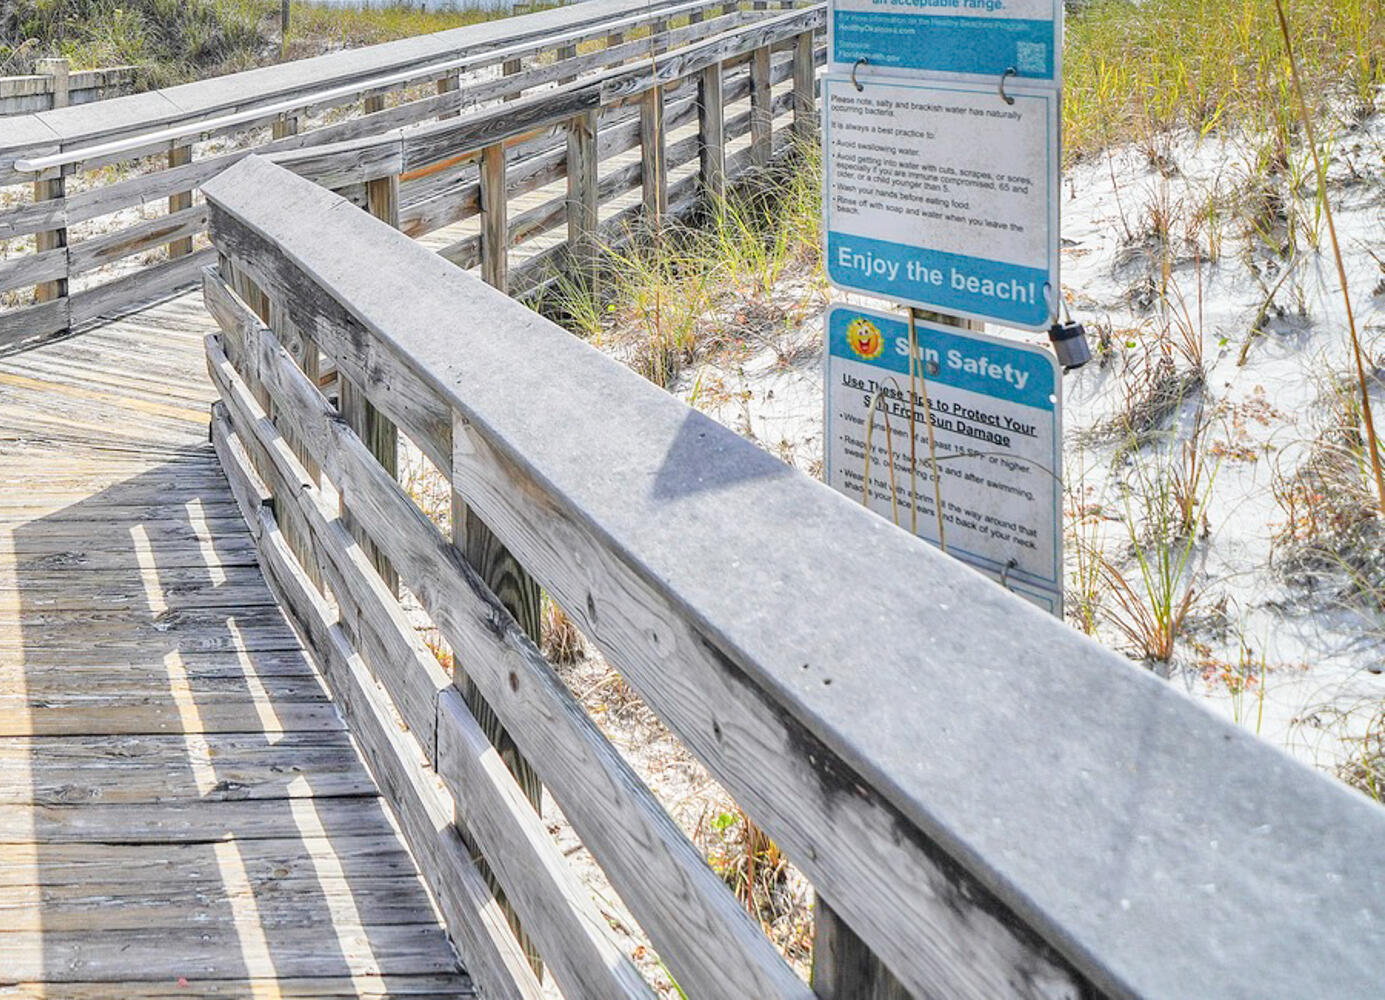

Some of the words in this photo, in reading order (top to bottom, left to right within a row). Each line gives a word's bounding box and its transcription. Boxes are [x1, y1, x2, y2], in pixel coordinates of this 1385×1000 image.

[831, 95, 855, 104] Please
[876, 100, 894, 109] salty
[911, 102, 943, 112] brackish
[945, 106, 967, 115] water
[969, 108, 984, 116] has
[986, 110, 1023, 121] naturally
[838, 122, 844, 130] is
[845, 123, 869, 133] always
[878, 126, 894, 135] best
[895, 128, 925, 138] practice
[836, 140, 857, 149] Avoid
[858, 143, 897, 156] swallowing
[836, 152, 856, 162] Avoid
[858, 156, 882, 167] getting
[899, 161, 920, 170] water
[922, 164, 937, 172] with
[836, 162, 871, 173] especially
[879, 168, 892, 176] you
[908, 172, 939, 182] immune
[999, 182, 1010, 192] 65
[1012, 186, 1029, 195] and
[872, 176, 890, 184] child
[892, 178, 922, 189] younger
[924, 182, 941, 192] than
[837, 183, 856, 192] Wash
[858, 187, 874, 195] your
[876, 189, 898, 199] hands
[899, 192, 924, 203] before
[926, 197, 950, 209] eating
[837, 194, 857, 206] Rinse
[870, 202, 884, 210] with
[886, 205, 905, 214] soap
[906, 208, 920, 216] and
[922, 211, 943, 220] water
[945, 214, 967, 223] when
[968, 218, 984, 226] you
[985, 219, 1009, 230] leave
[1010, 223, 1024, 233] the
[838, 246, 901, 281] Enjoy
[906, 260, 944, 286] the
[950, 268, 1036, 305] beach!
[946, 349, 1029, 390] Safety
[842, 373, 865, 390] Use
[936, 400, 949, 413] to
[953, 403, 1000, 427] Protect
[1004, 415, 1037, 436] Your
[864, 394, 889, 413] Sin
[929, 412, 953, 431] Sun
[956, 420, 1012, 448] Damage
[844, 412, 865, 425] Wear
[988, 456, 999, 464] or
[944, 466, 962, 478] and
[964, 472, 985, 485] after
[844, 468, 865, 481] Wear
[874, 478, 888, 490] hat
[948, 502, 962, 514] the
[964, 508, 983, 522] way
[984, 515, 1017, 532] around
[1018, 525, 1037, 539] that
[956, 516, 977, 532] back
[979, 524, 988, 534] of
[990, 530, 1011, 541] your
